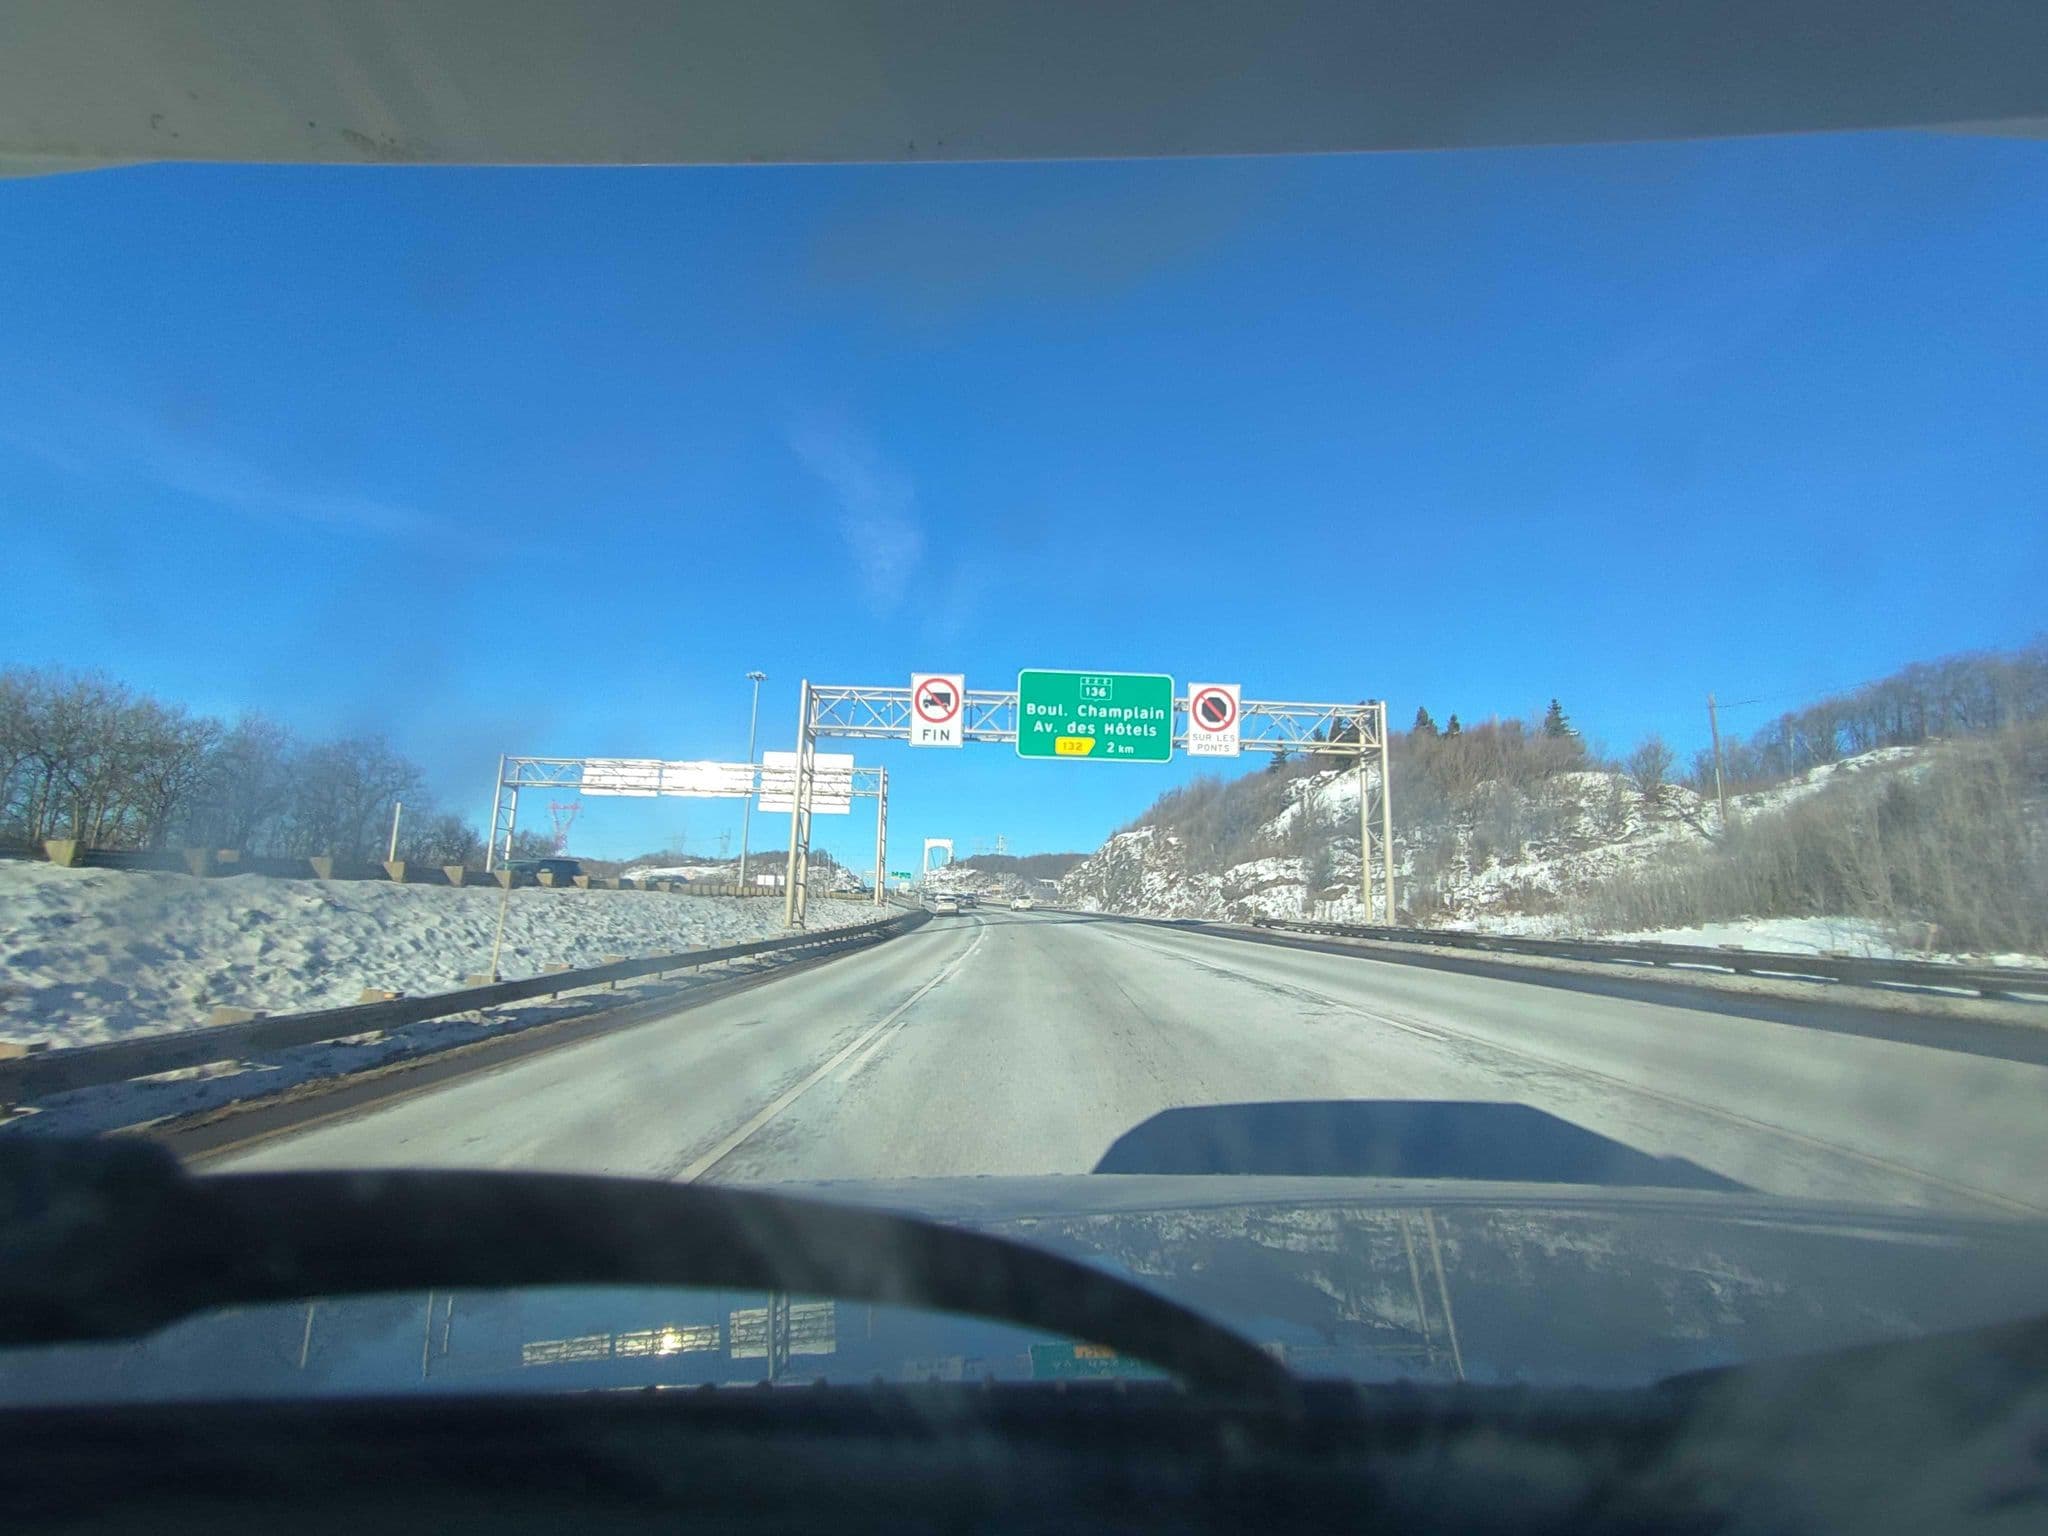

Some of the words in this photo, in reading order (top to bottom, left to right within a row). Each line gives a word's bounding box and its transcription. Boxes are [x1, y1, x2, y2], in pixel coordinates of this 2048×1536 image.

[1085, 687, 1106, 697] 136
[1026, 703, 1067, 716] Boul.
[1078, 705, 1164, 721] Champlain
[1034, 721, 1057, 733] Av.
[1067, 721, 1095, 734] des
[1104, 722, 1157, 736] Hôtels
[922, 729, 950, 741] FIN
[1193, 733, 1212, 741] SUR
[1063, 742, 1083, 751] 132
[1107, 742, 1114, 753] 2
[1118, 743, 1134, 753] km
[1197, 744, 1230, 752] PONTS
